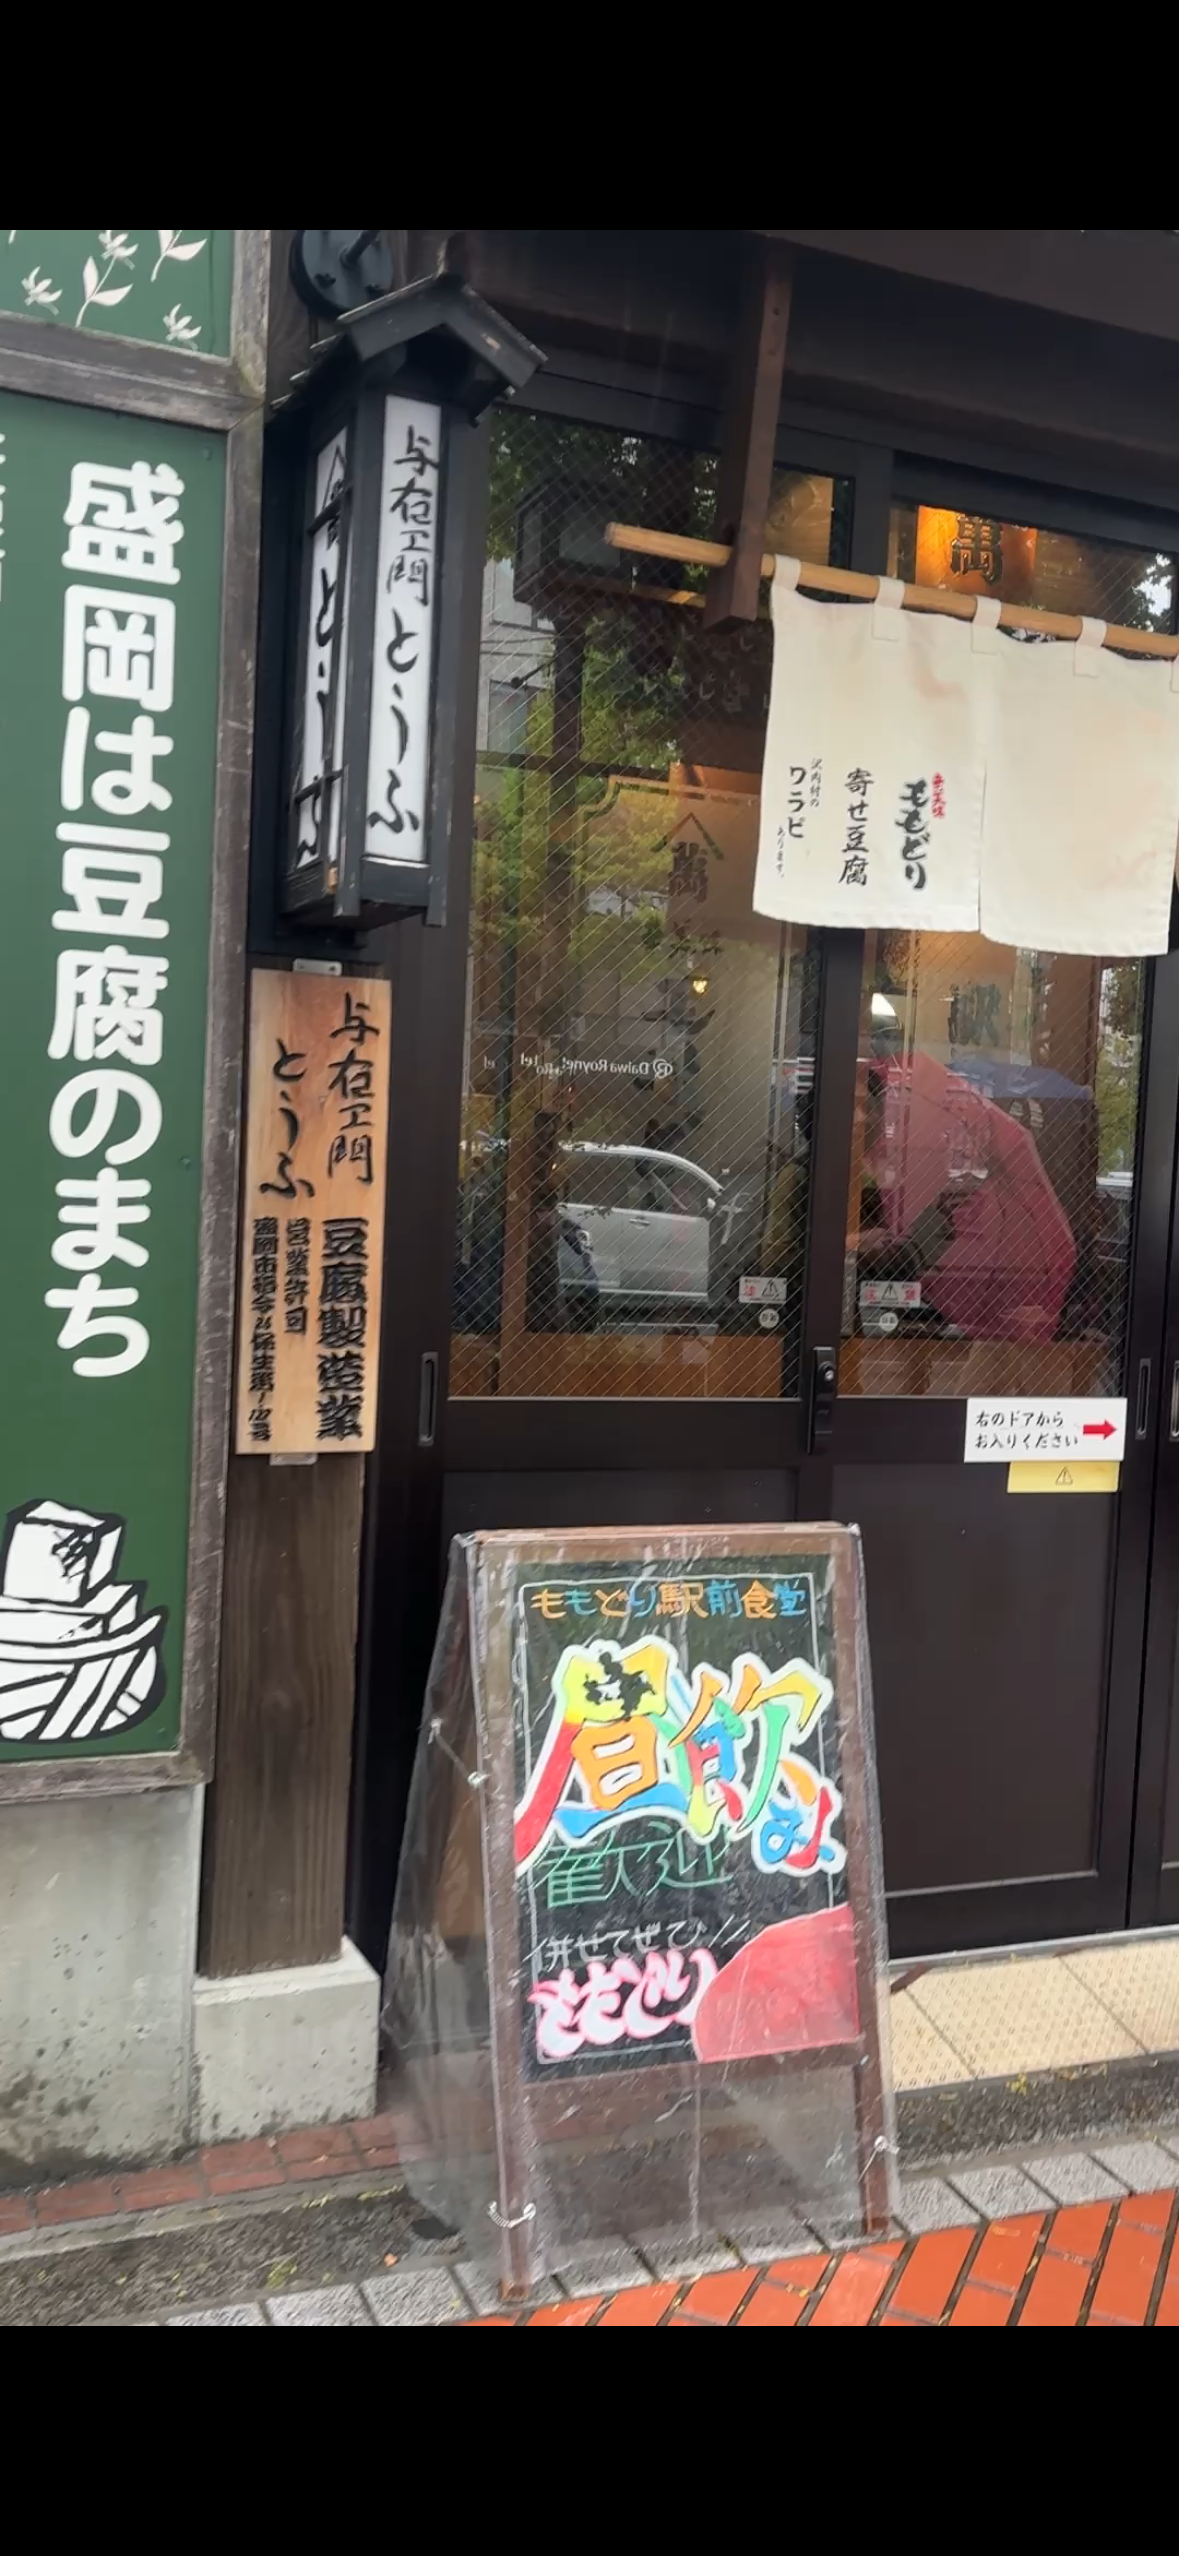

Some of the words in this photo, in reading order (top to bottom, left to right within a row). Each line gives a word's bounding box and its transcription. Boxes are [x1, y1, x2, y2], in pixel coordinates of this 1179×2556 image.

[787, 766, 807, 838] ワラビ
[838, 767, 875, 886] 寄せ豆腐
[894, 777, 930, 891] ももどり
[45, 461, 185, 1378] 盛岡は豆腐のまち
[259, 1037, 316, 1199] とうふ
[315, 1216, 370, 1441] 豆腐製造業
[974, 1432, 1079, 1450] お入りください
[975, 1410, 1065, 1428] 右のドアから
[531, 1579, 807, 1620] ももどり駅前食堂
